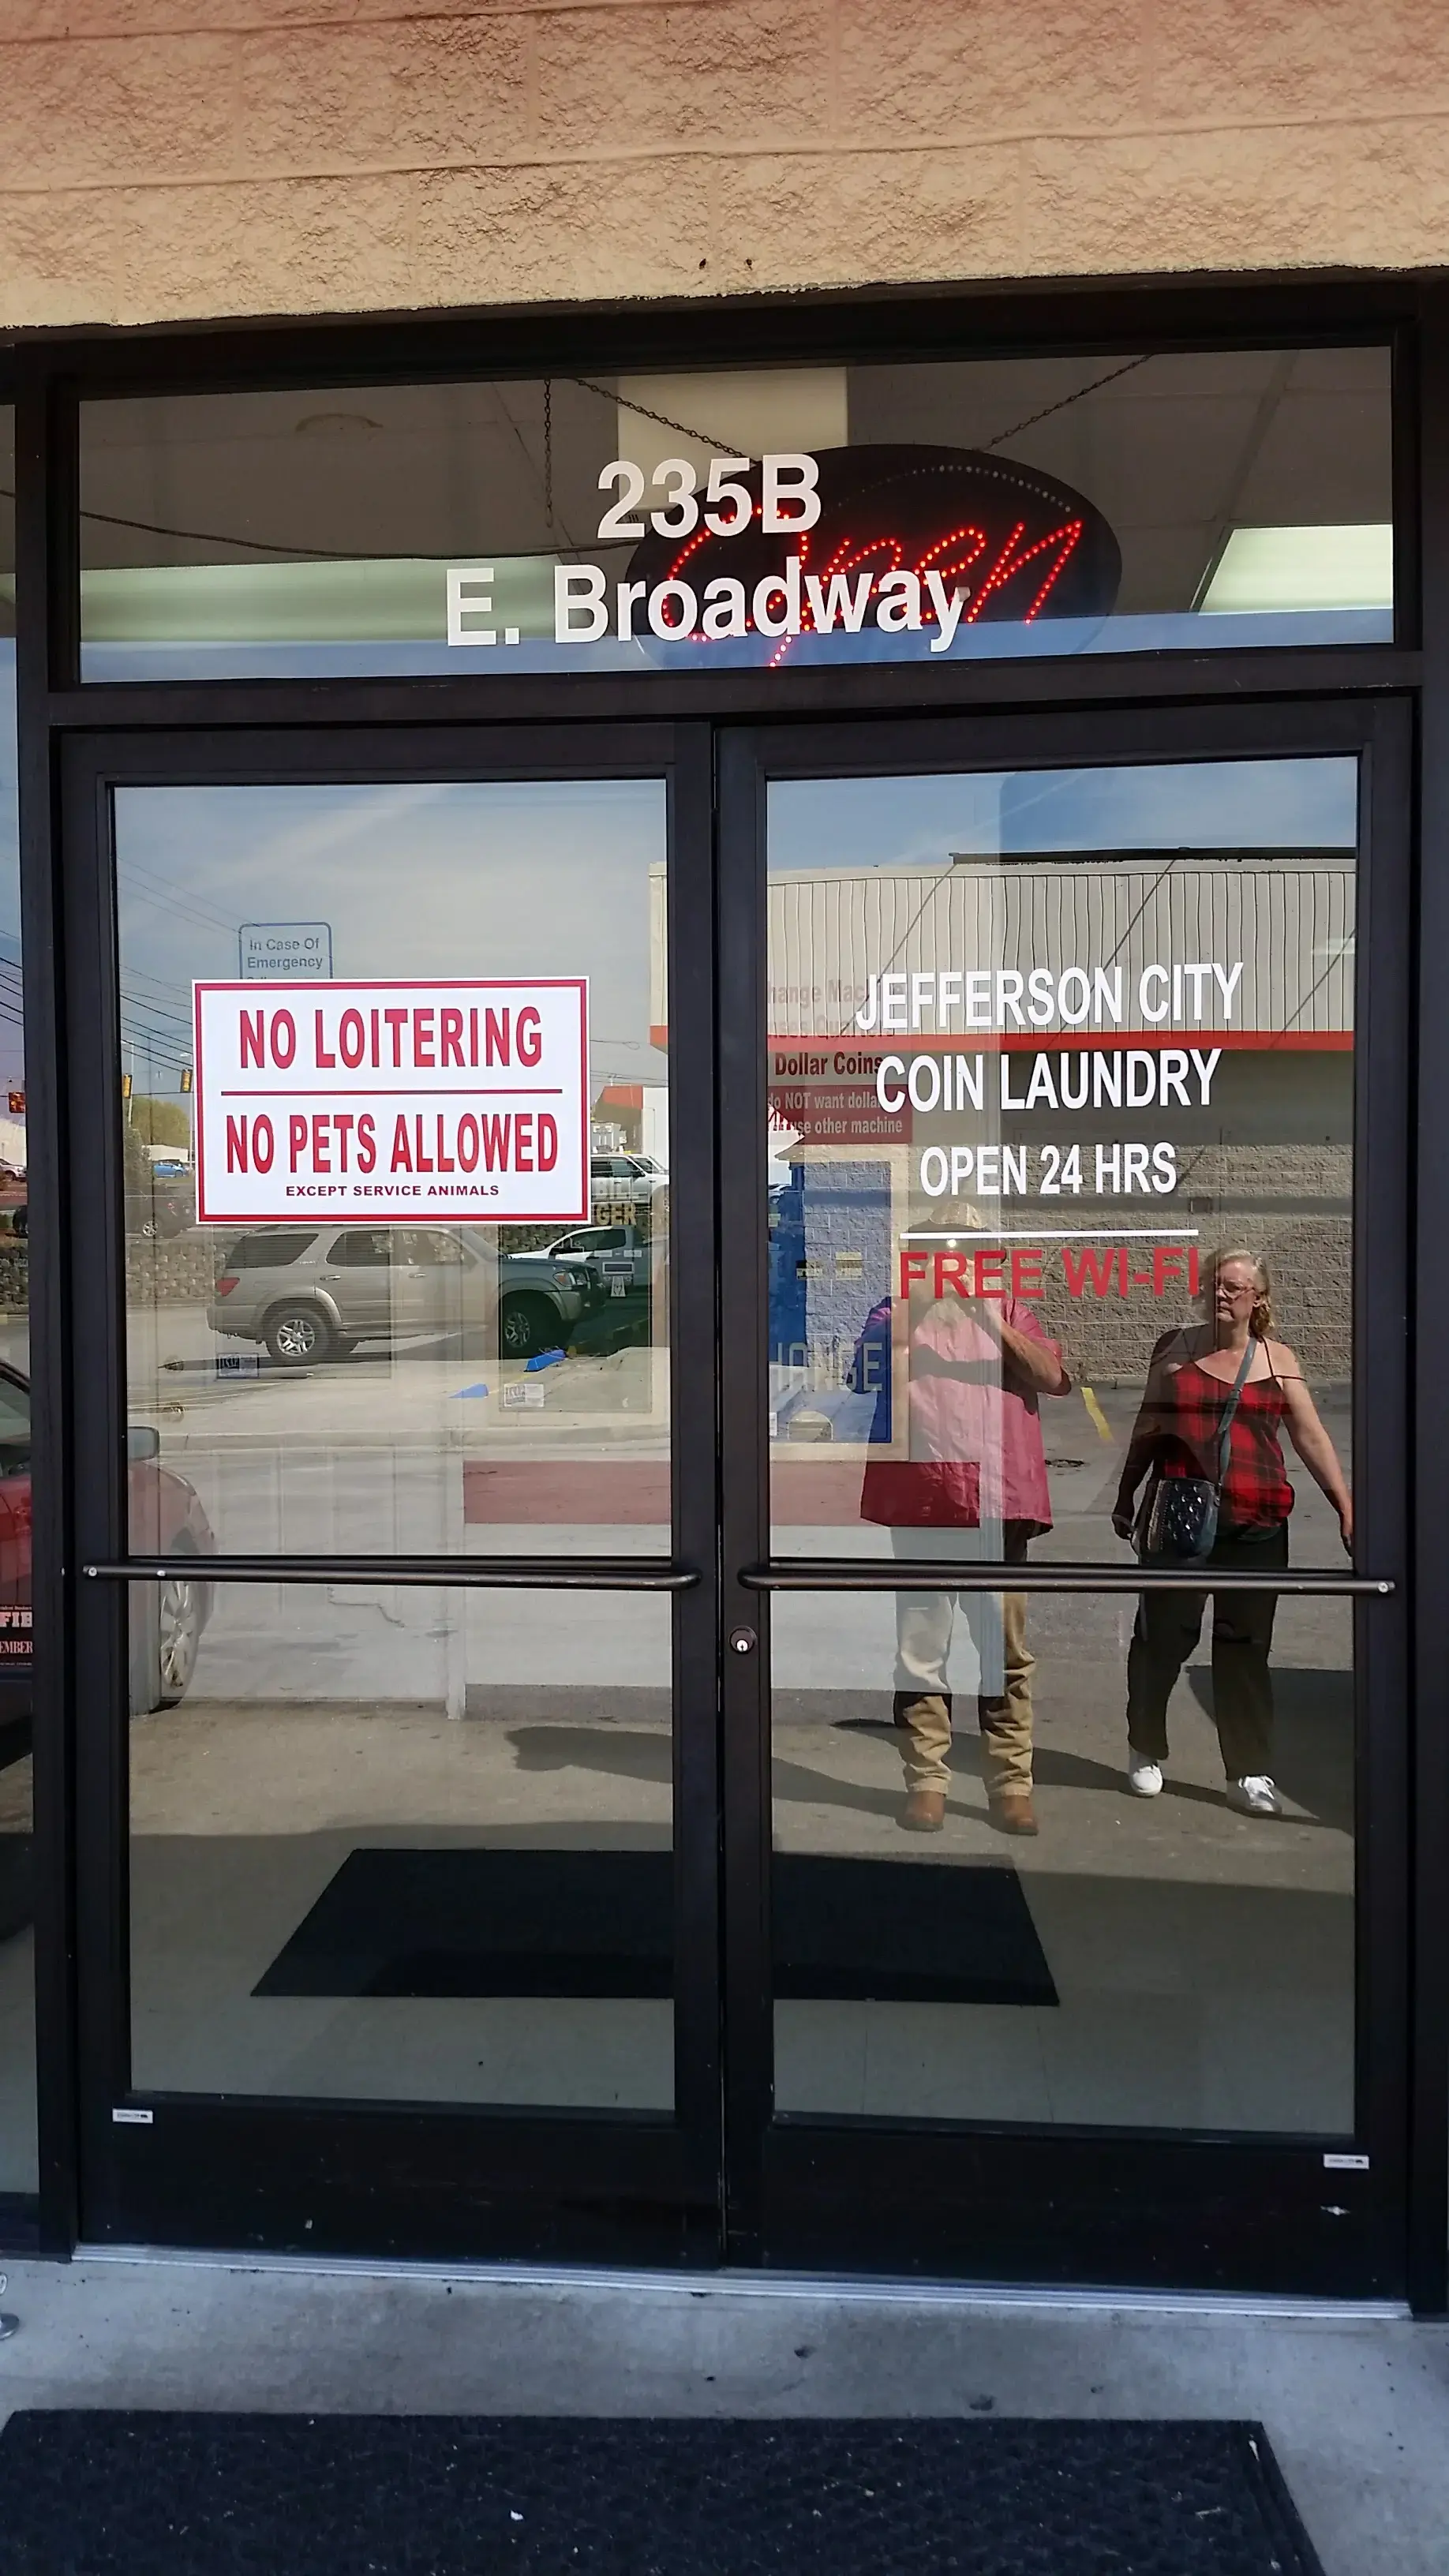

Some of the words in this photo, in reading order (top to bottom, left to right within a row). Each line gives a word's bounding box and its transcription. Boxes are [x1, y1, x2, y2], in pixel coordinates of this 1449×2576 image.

[597, 453, 822, 539] 235B
[447, 567, 521, 647] E.
[554, 556, 972, 653] Broadway
[247, 957, 323, 971] Emergency
[249, 939, 262, 951] In
[266, 938, 300, 950] Case
[304, 938, 320, 949] Of
[856, 967, 1121, 1032] JEFFERSON
[1139, 962, 1245, 1024] CITY
[240, 1009, 296, 1069] NO
[316, 1006, 542, 1069] LOITERING
[775, 1052, 828, 1076] Dollar
[833, 1051, 882, 1075] Coins
[785, 1092, 811, 1108] NOT
[814, 1094, 844, 1109] want
[848, 1091, 881, 1108] dolla
[876, 1054, 984, 1114] COIN
[1000, 1048, 1222, 1111] LAUNDRY
[227, 1114, 275, 1174] NO
[290, 1114, 376, 1174] PETS
[391, 1114, 558, 1174] ALLOWED
[814, 1118, 848, 1133] other
[851, 1116, 903, 1133] machine
[286, 1185, 348, 1197] EXCEPT
[353, 1185, 421, 1196] SERVICE
[427, 1185, 500, 1196] ANIMALS
[919, 1146, 1027, 1196] OPEN
[1039, 1145, 1083, 1195] 24
[1095, 1142, 1178, 1194] HRS
[900, 1250, 1043, 1301] FREE
[1062, 1248, 1199, 1299] WI-FI
